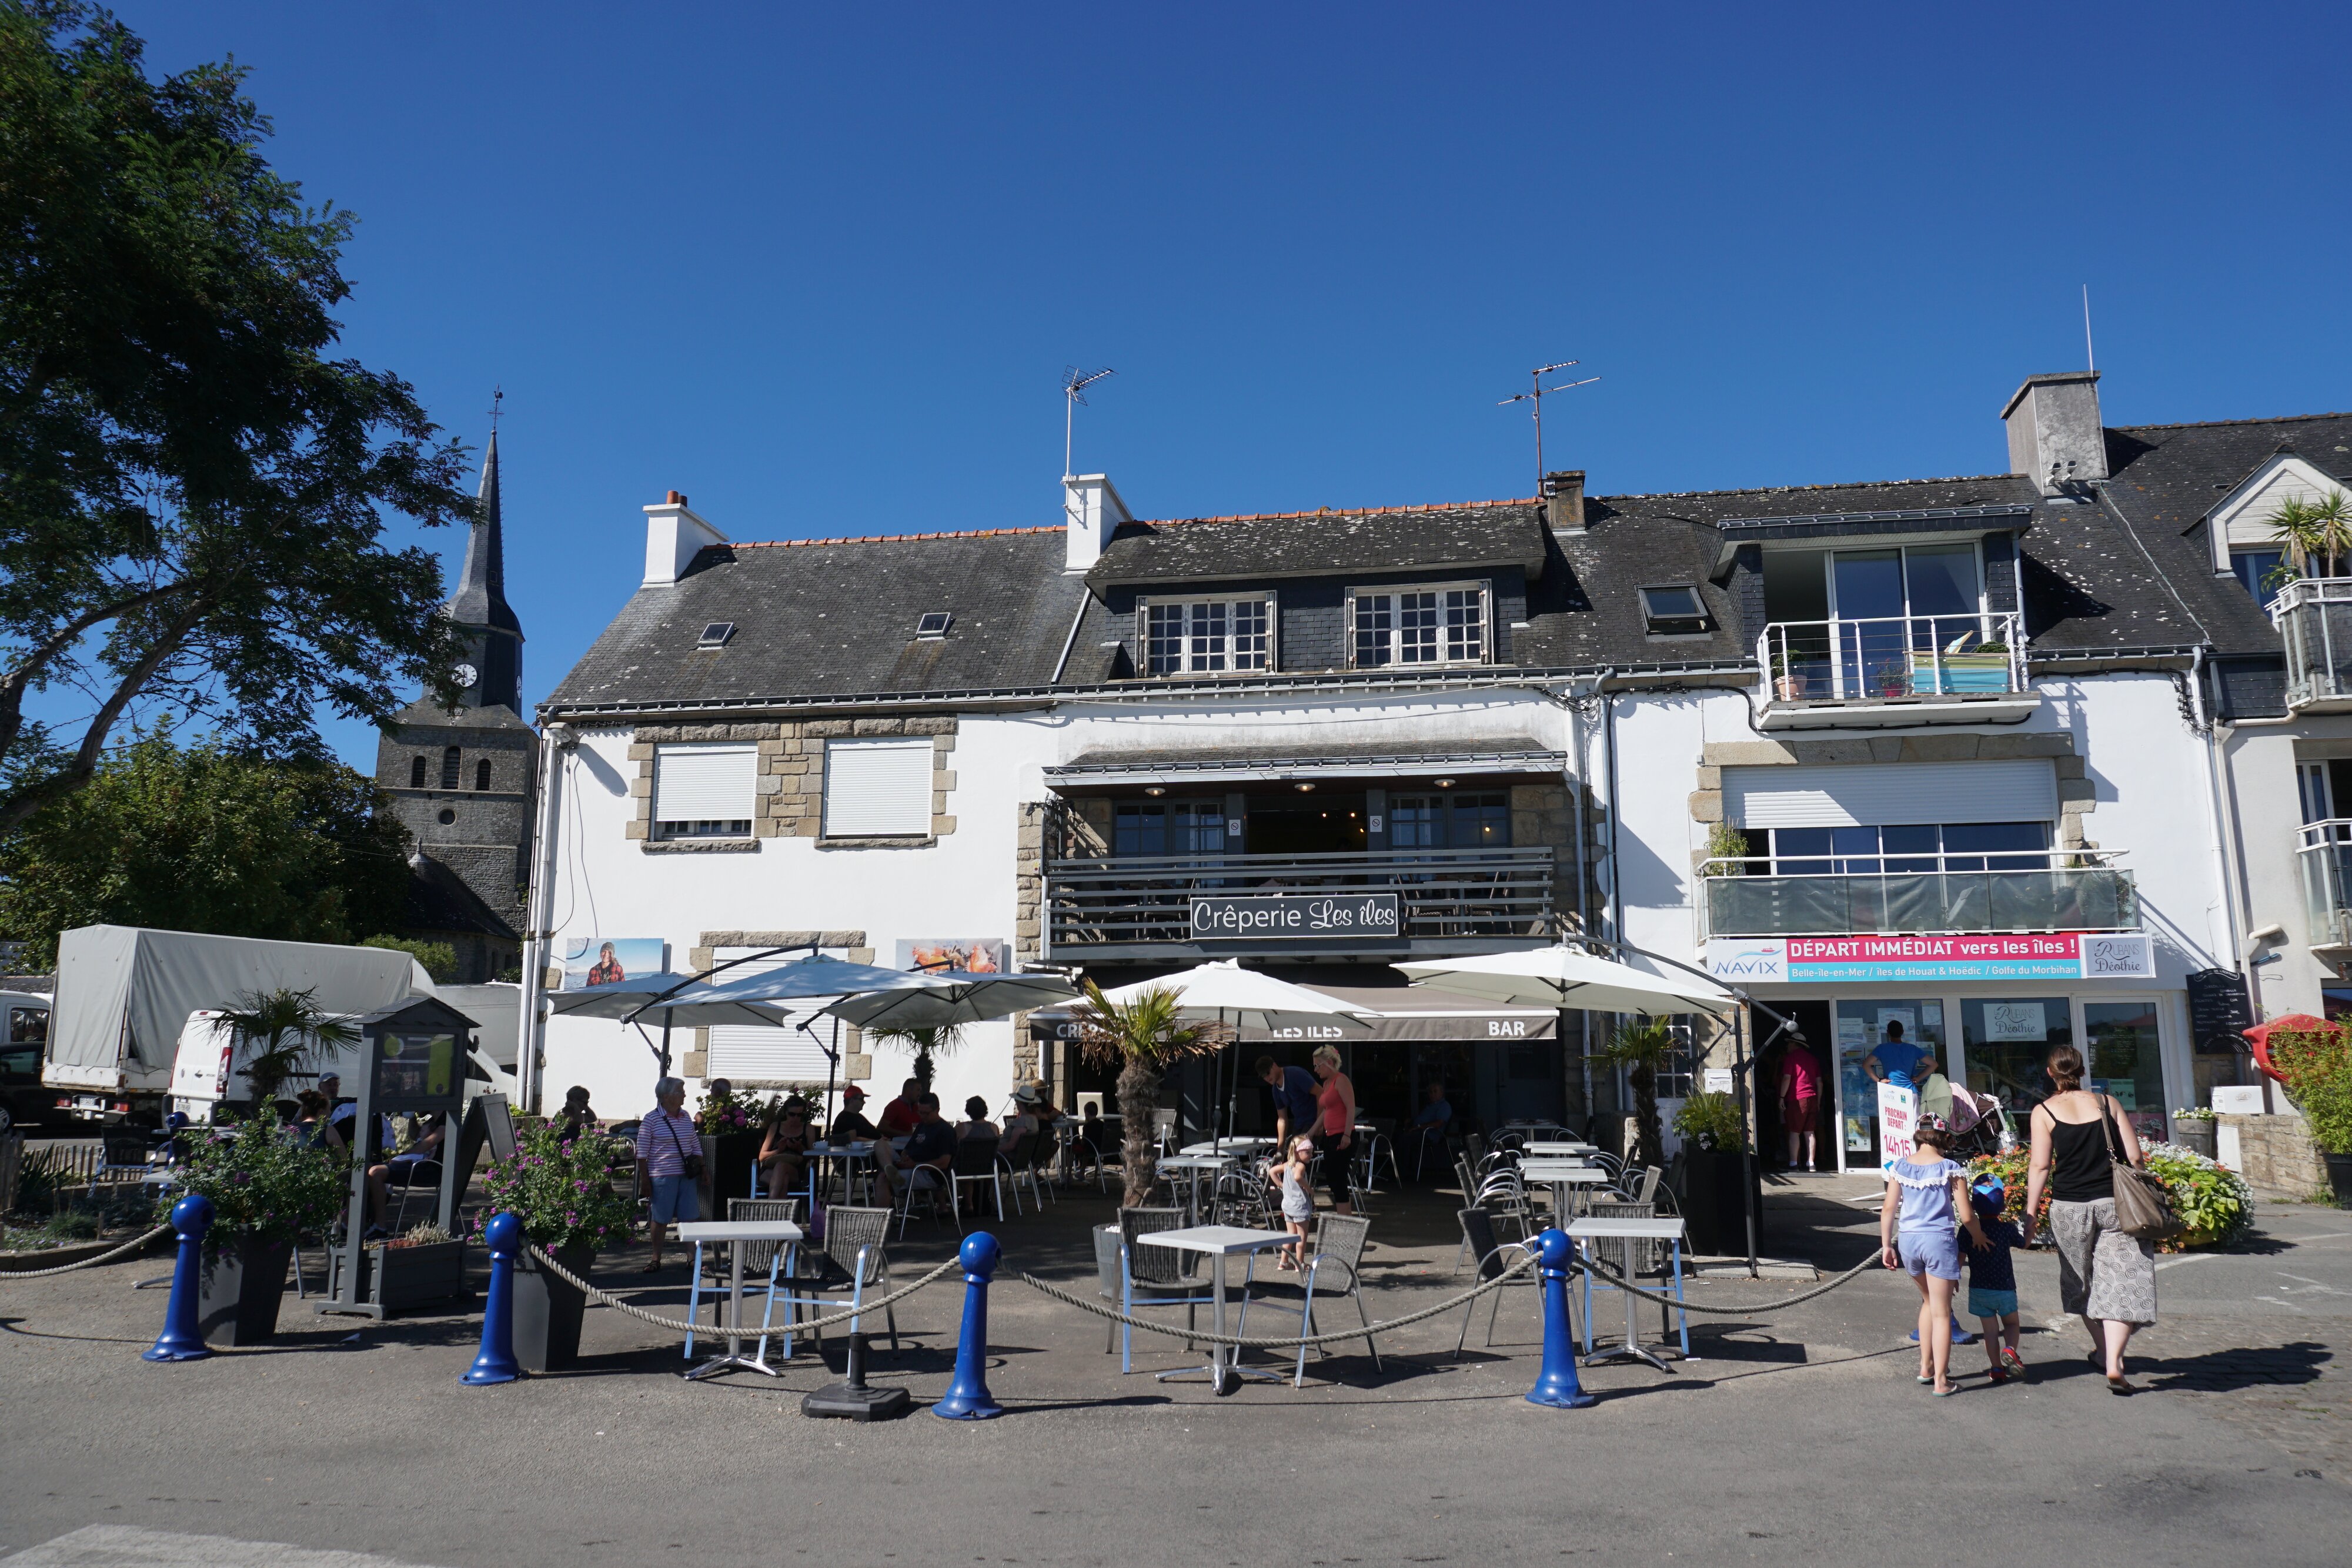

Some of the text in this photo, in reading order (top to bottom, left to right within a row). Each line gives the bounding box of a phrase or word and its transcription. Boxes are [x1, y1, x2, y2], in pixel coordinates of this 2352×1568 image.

[1194, 898, 1395, 934] Crêperie Les îles
[1790, 940, 1860, 957] DÉPART
[1866, 938, 1954, 957] IMMÉDIAT
[1960, 943, 1999, 955] vers
[2003, 941, 2029, 955] les
[2032, 939, 2065, 954] îles
[1714, 957, 1778, 974] NAVIX
[1792, 968, 1867, 978] Belle-île-en-Mer
[1876, 967, 1893, 977] îles
[1895, 967, 1906, 976] de
[1909, 967, 1937, 976] Houat
[1939, 966, 1946, 976] &
[1949, 965, 1982, 975] Hoëdic
[1992, 965, 2016, 975] Golfe
[2018, 965, 2030, 975] du
[2032, 964, 2077, 975] Morbihan
[2094, 958, 2141, 972] Déothie
[1488, 1021, 1525, 1036] BAR
[1995, 1021, 2036, 1034] Déothie
[1885, 1106, 1907, 1121] PROCHAIN
[1887, 1116, 1904, 1130] DEPART
